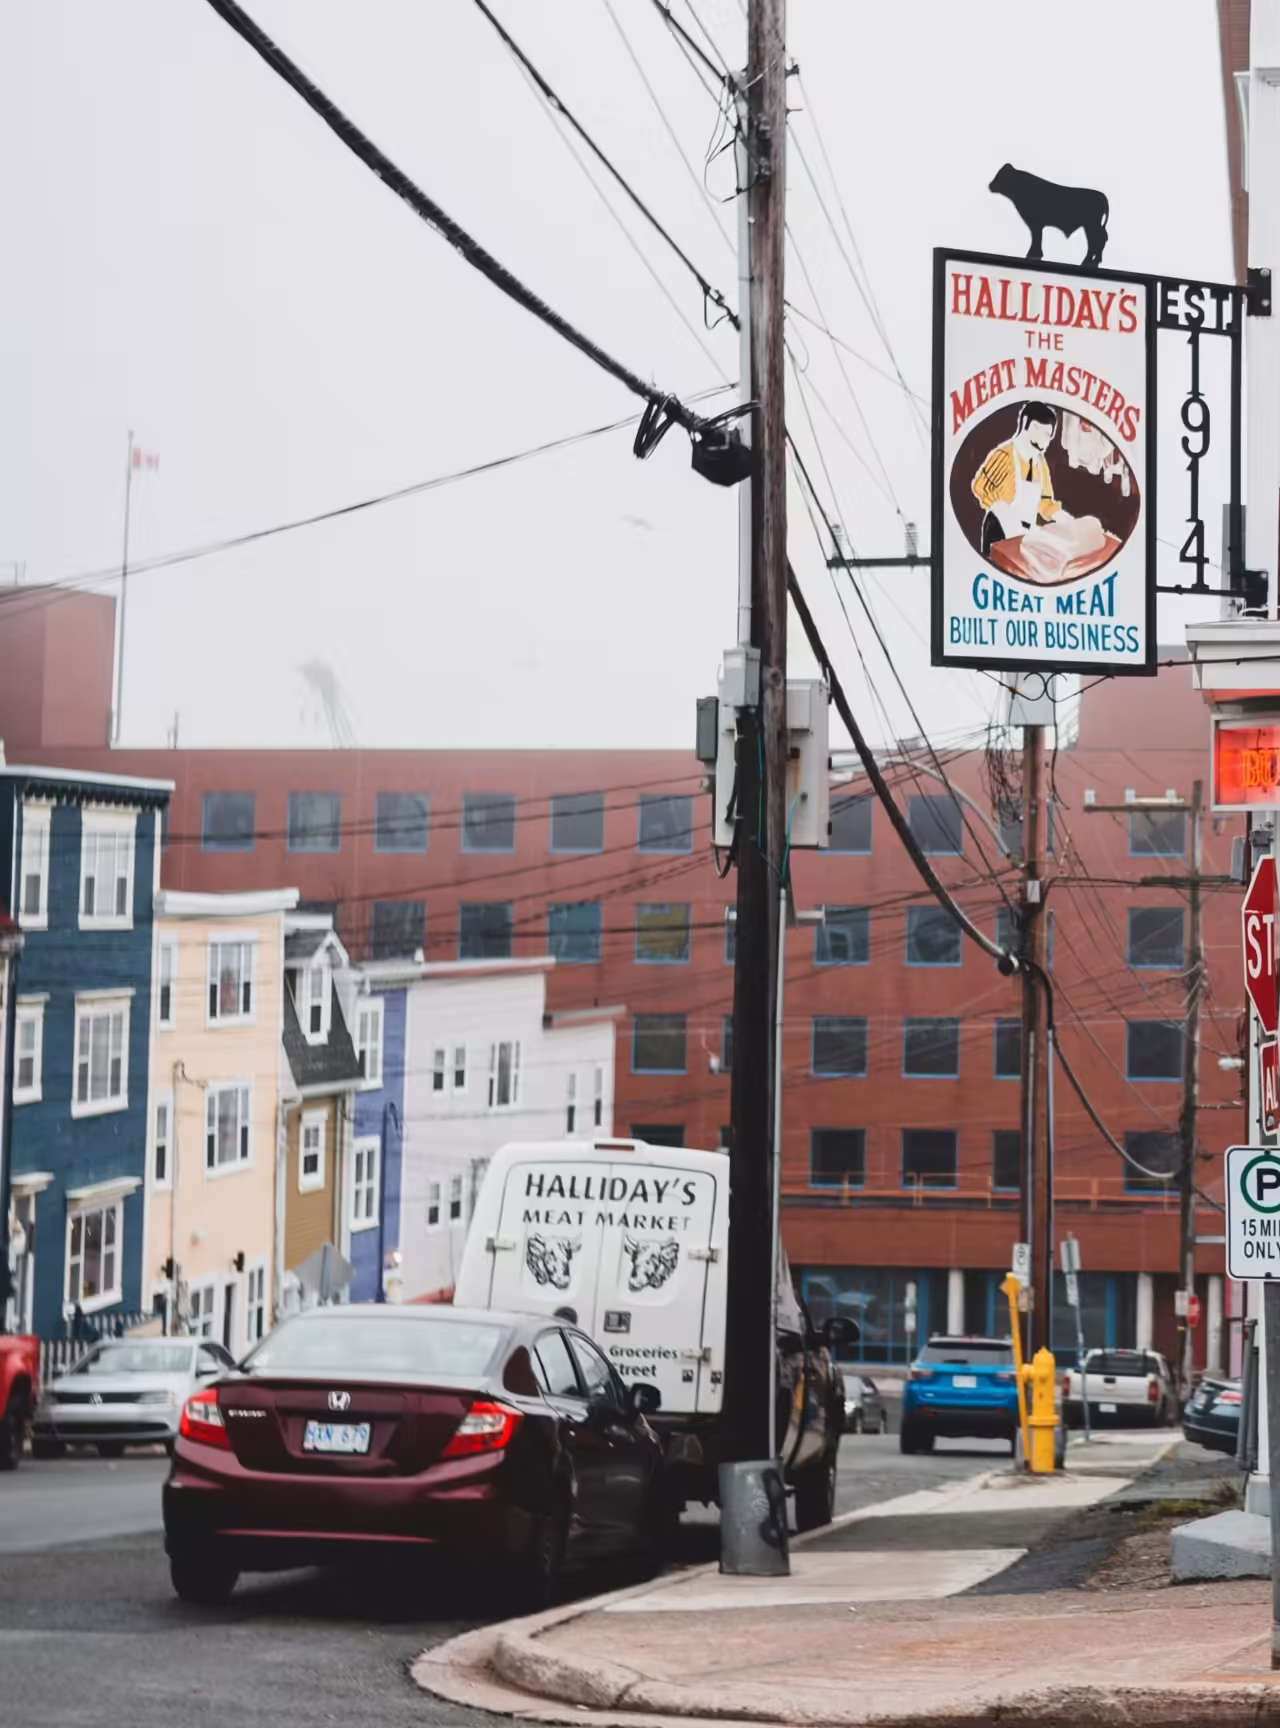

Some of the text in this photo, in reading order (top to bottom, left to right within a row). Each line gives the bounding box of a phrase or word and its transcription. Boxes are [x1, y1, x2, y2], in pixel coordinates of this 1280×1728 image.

[951, 273, 1138, 333] HALLIDAY'S
[1024, 330, 1064, 351] THE
[950, 357, 1141, 443] MEAT MASTERS
[1180, 330, 1211, 591] 1914
[972, 571, 1119, 617] GREAT MEAT
[950, 616, 1140, 653] BUILT OUR BUSINESS
[1247, 914, 1276, 979] ST
[525, 1173, 697, 1206] HALLIDAY'S
[522, 1209, 692, 1231] MEAT MARKET
[1241, 1219, 1257, 1237] 15
[609, 1345, 678, 1359] Groceries
[613, 1363, 657, 1377] treet
